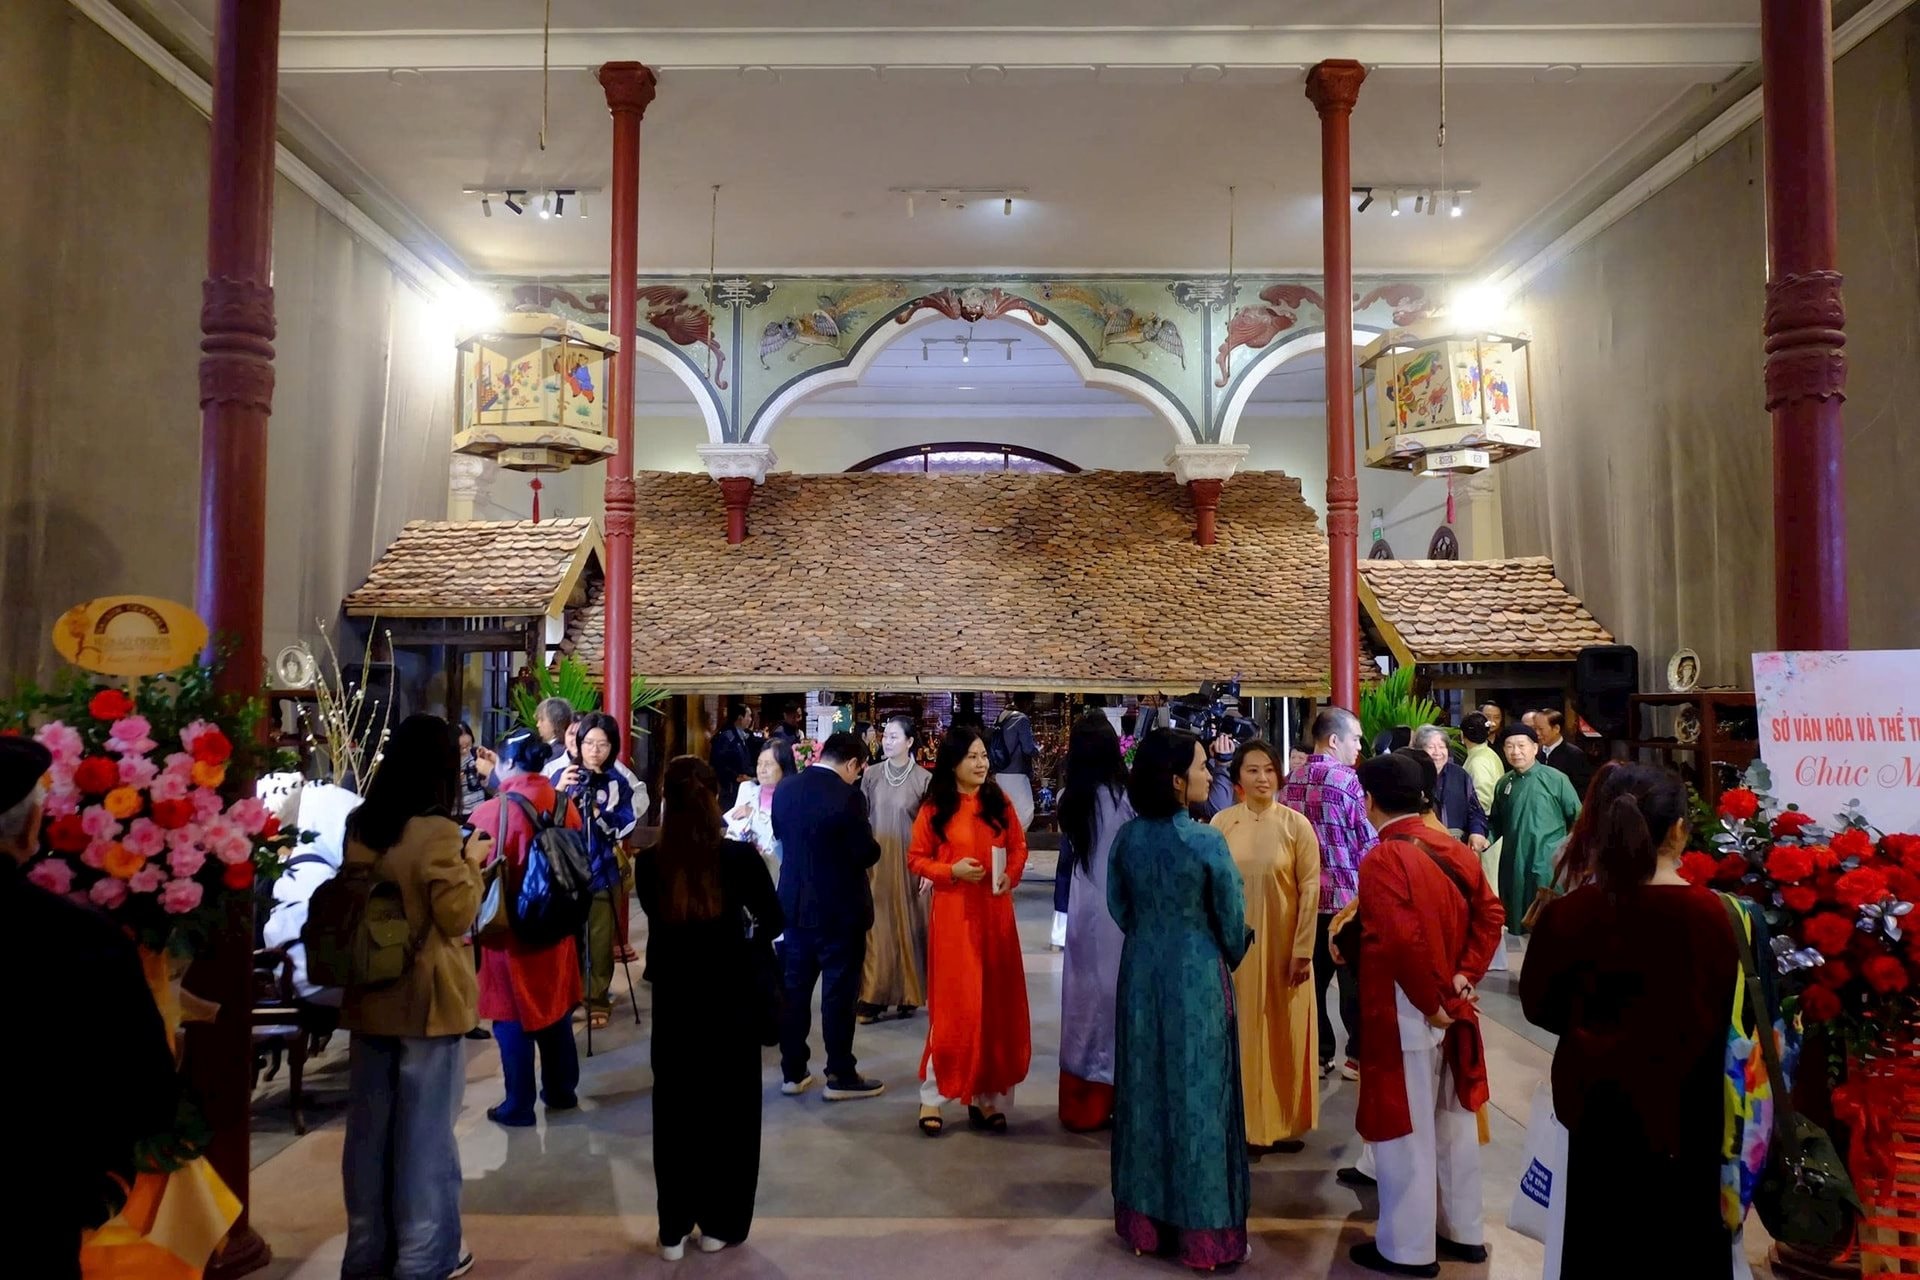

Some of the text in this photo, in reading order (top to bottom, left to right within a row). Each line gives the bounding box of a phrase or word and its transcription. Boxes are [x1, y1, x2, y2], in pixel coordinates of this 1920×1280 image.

[1772, 710, 1791, 742] SỞ
[1794, 712, 1823, 742] VĂN
[1825, 712, 1854, 742] HÓA
[1856, 712, 1876, 742] VÀ
[1878, 707, 1906, 742] THỂ
[1795, 755, 1869, 787] Chúc
